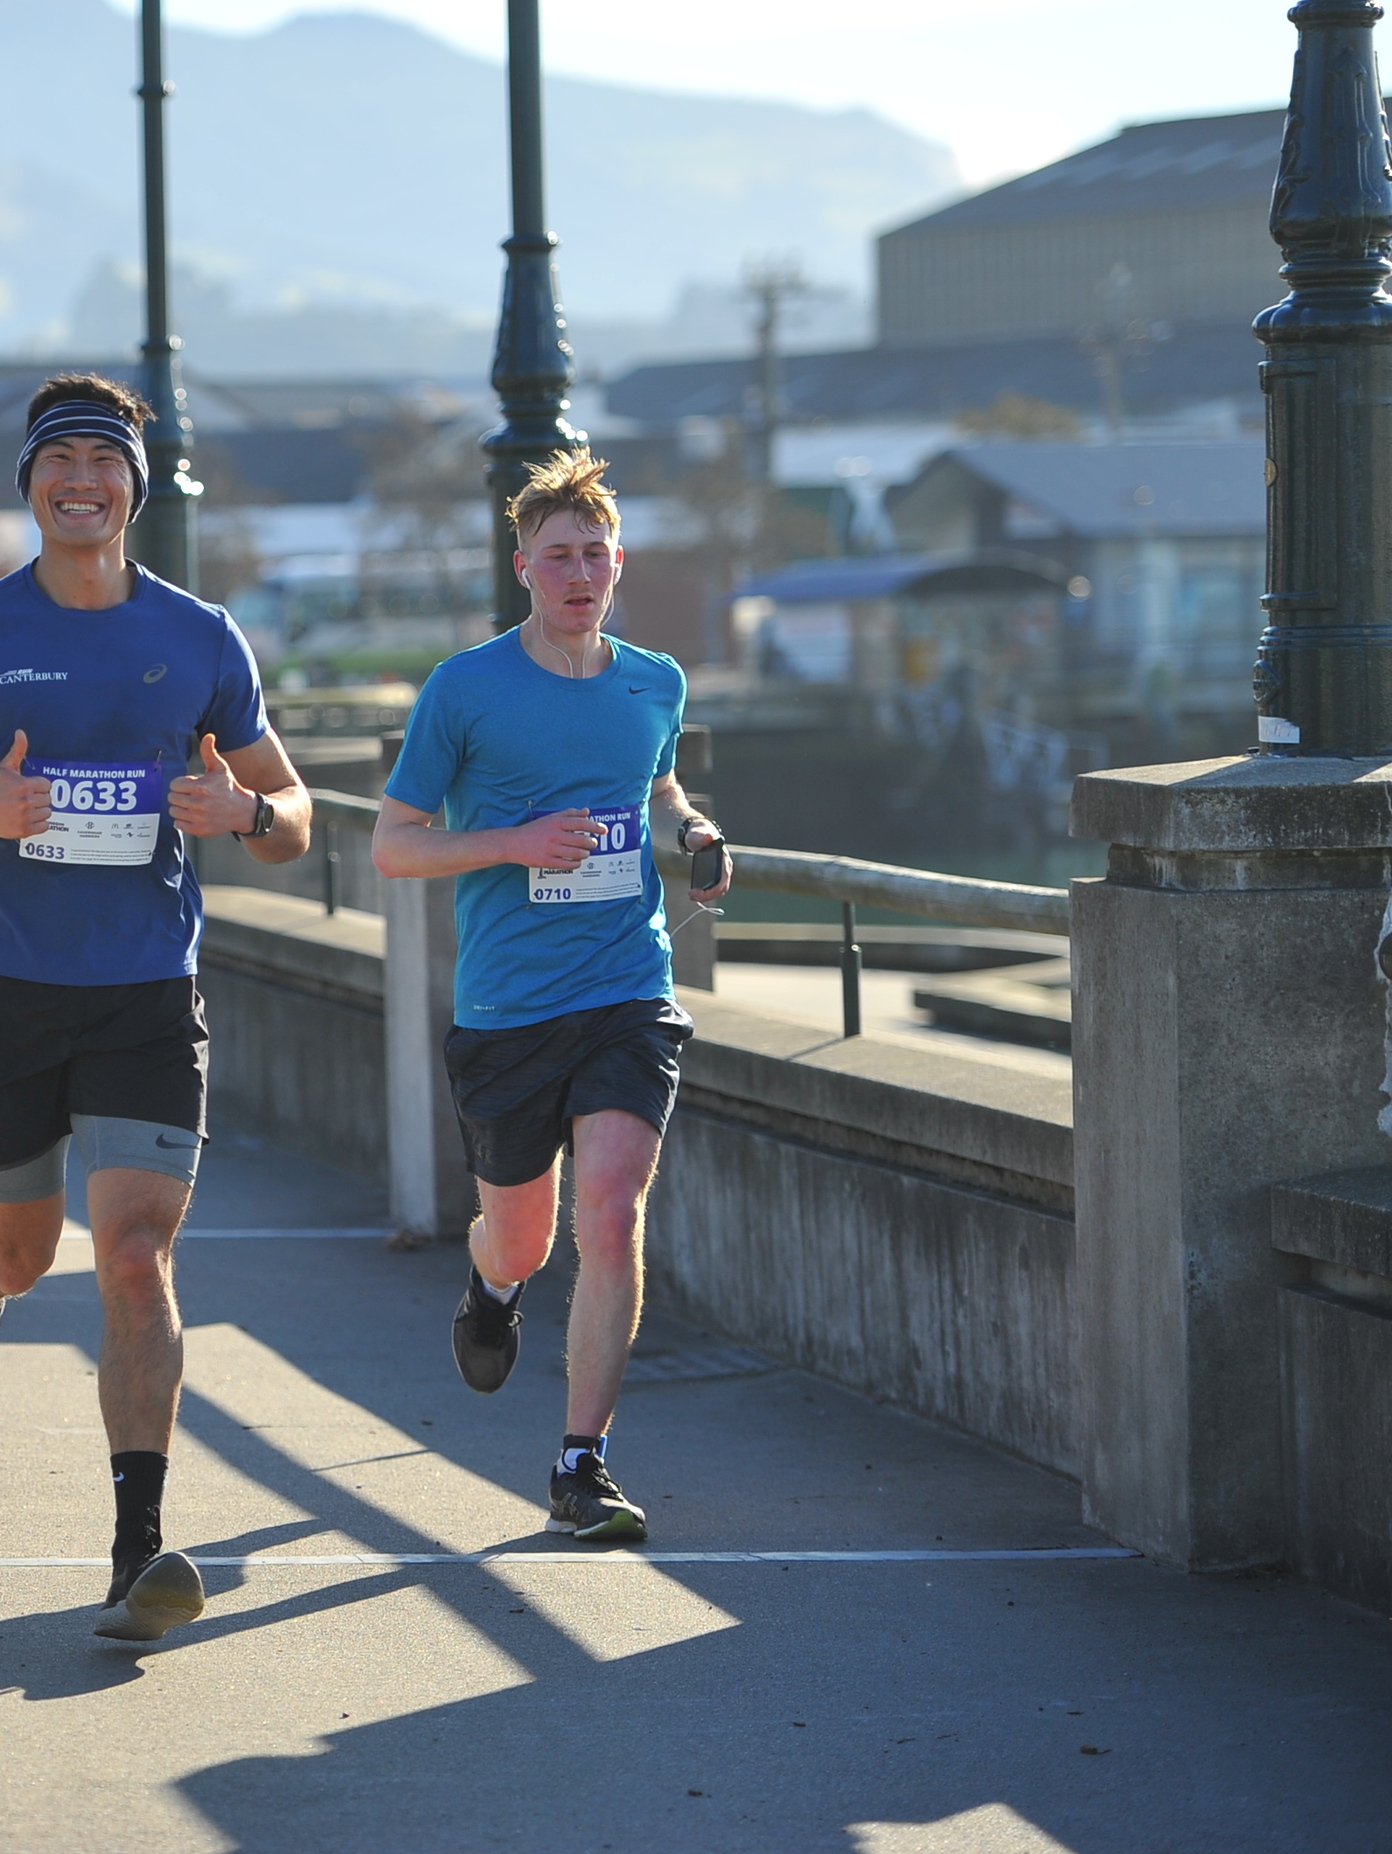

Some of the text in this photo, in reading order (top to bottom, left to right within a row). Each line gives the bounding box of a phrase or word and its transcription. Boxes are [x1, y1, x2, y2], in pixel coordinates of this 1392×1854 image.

[43, 766, 146, 779] HALF MARATHON RUN
[49, 779, 137, 811] 0633
[617, 812, 631, 821] RUN
[26, 842, 65, 860] 0633
[535, 888, 572, 901] 0710
